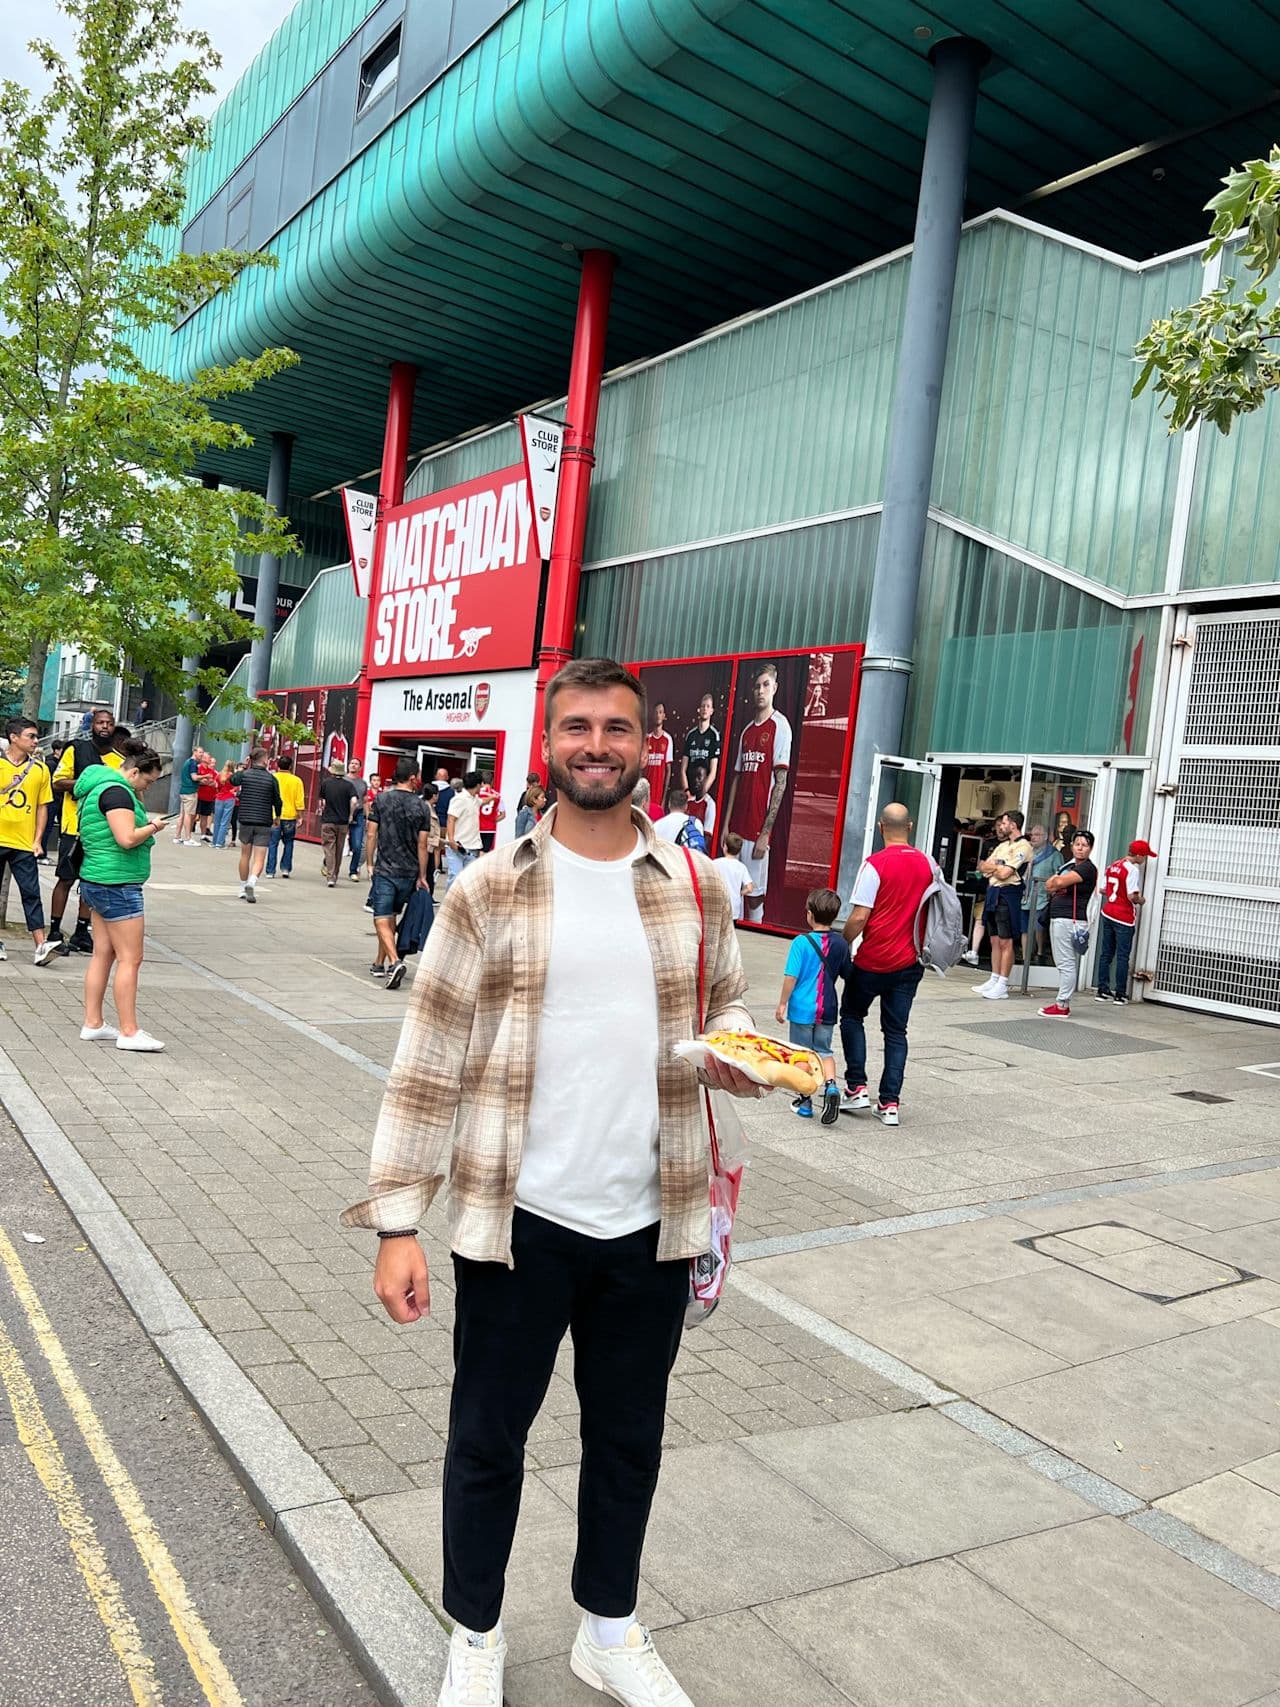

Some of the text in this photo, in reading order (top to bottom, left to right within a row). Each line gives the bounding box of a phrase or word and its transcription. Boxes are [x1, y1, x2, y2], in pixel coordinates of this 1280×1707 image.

[531, 438, 558, 454] STORE
[538, 430, 559, 444] CLUB
[351, 506, 374, 517] STORE
[356, 499, 374, 510] CLUB
[381, 479, 533, 594] MATCHDAY
[373, 580, 461, 666] STORE
[403, 685, 473, 711] The Arsenal
[1108, 876, 1119, 903] 7
